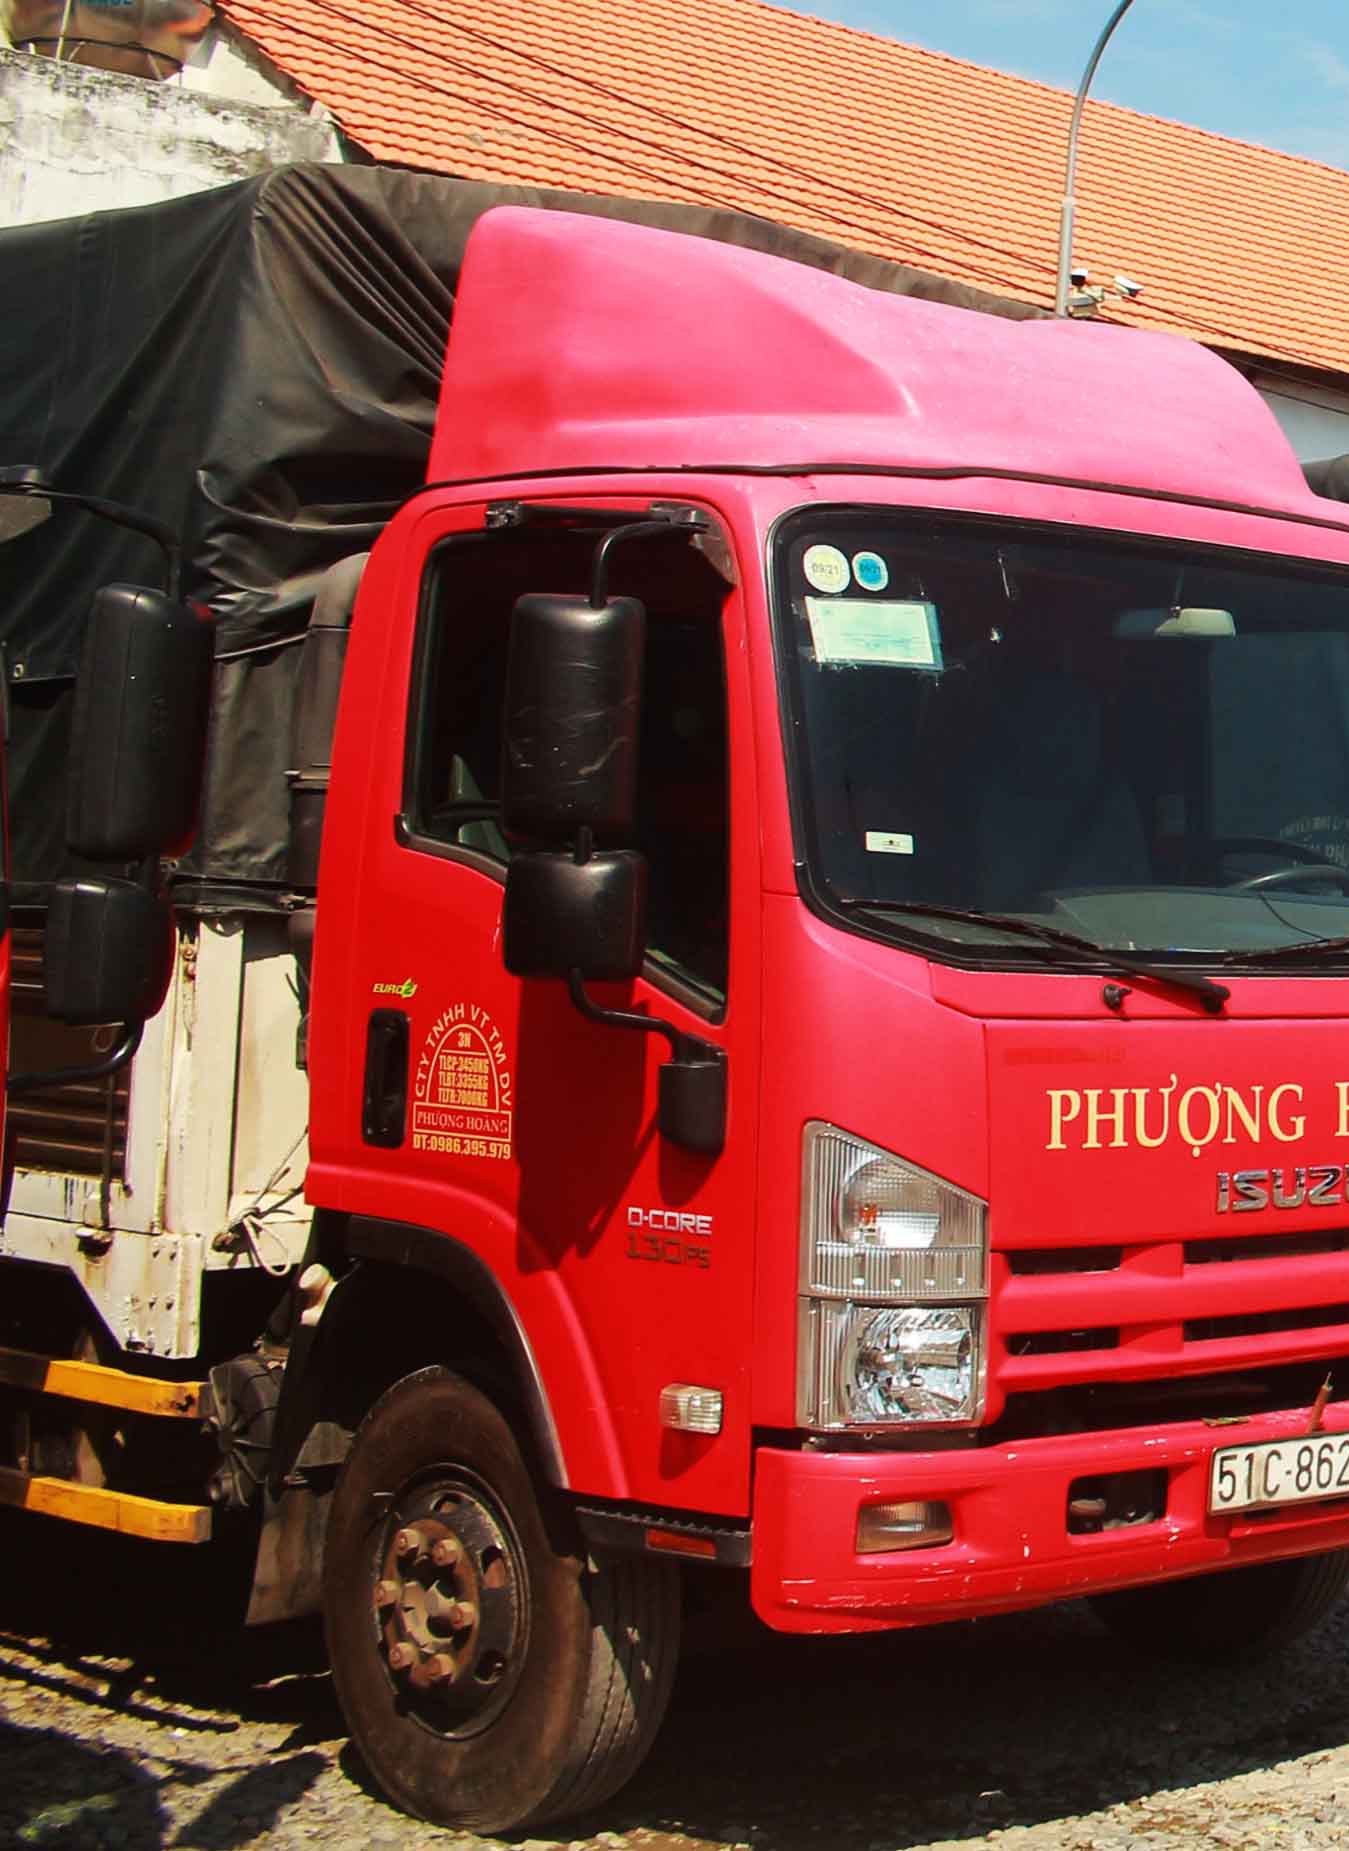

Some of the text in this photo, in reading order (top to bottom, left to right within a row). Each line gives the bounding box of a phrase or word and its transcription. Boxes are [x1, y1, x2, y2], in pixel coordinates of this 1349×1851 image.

[415, 1002, 512, 1106] CTY TNHH VT TM DV
[1046, 1073, 1307, 1158] PHƯỢNG
[628, 1206, 713, 1236] D-CORE
